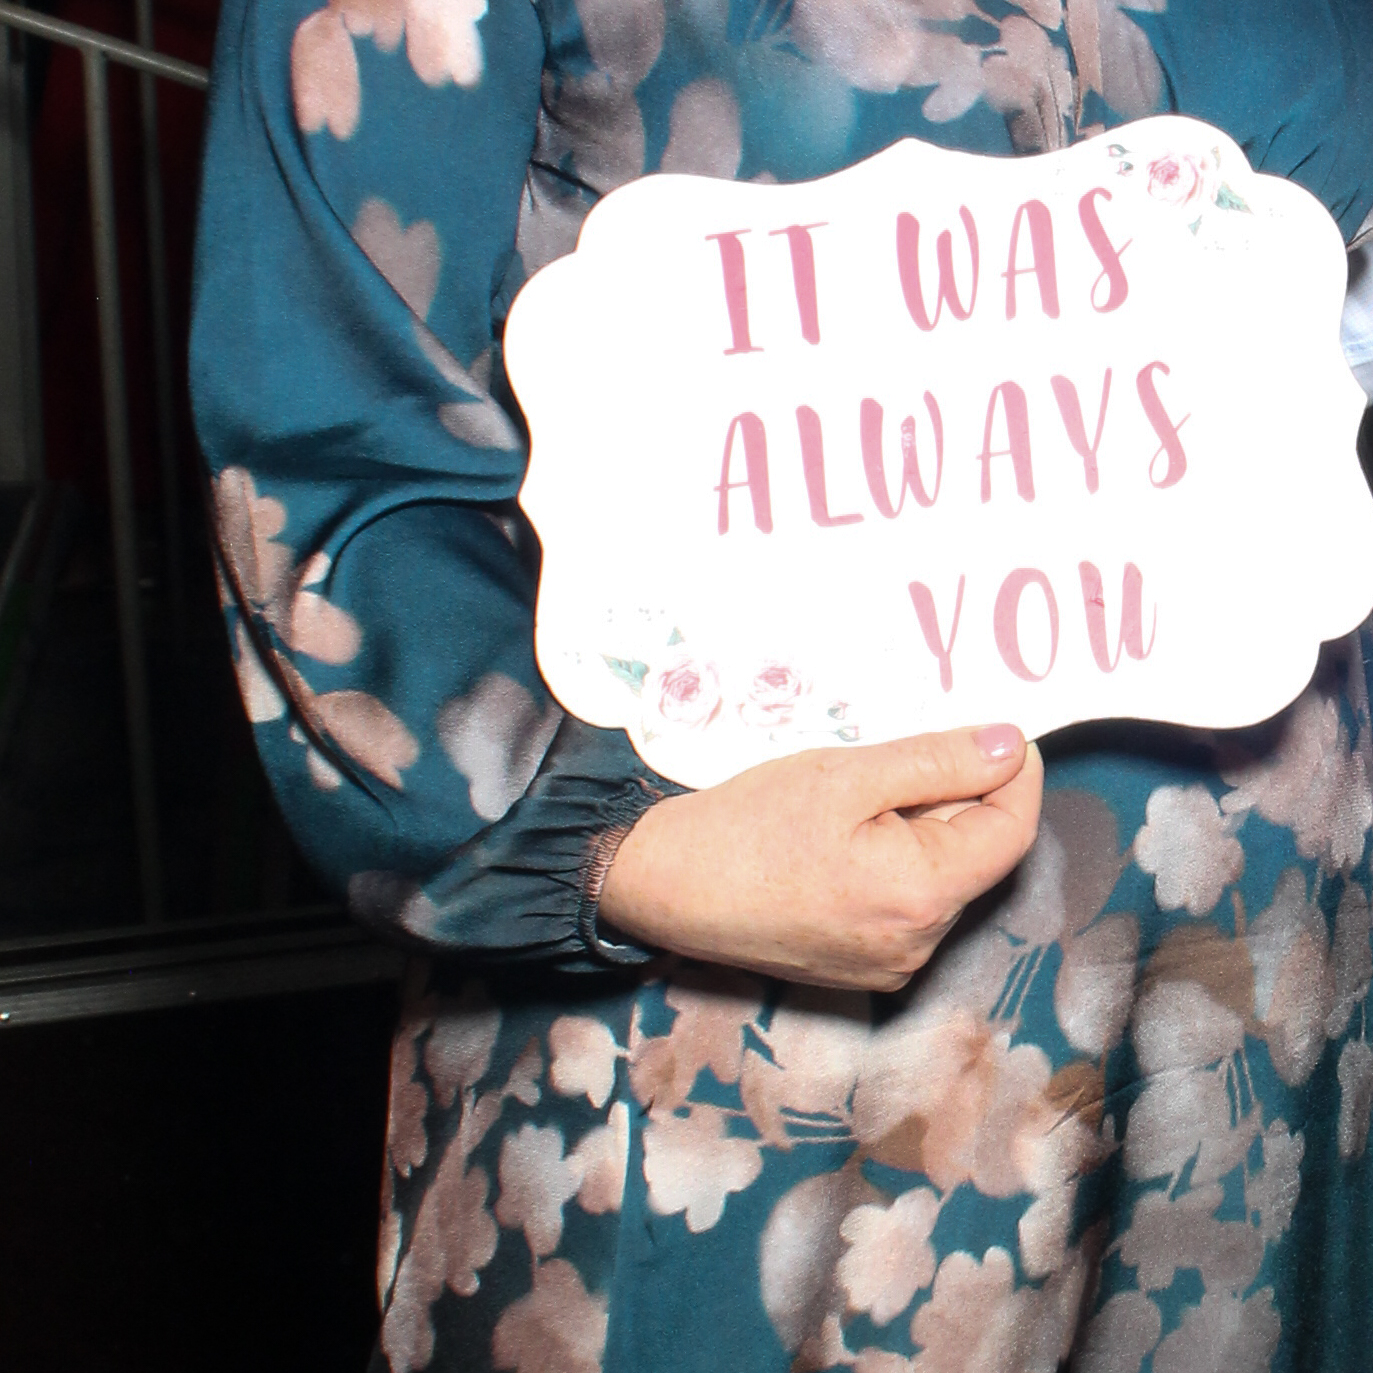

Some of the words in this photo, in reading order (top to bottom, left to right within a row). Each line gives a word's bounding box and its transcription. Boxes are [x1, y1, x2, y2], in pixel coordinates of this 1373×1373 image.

[705, 223, 829, 356] IT
[896, 187, 1133, 332] WAS
[713, 360, 1190, 535] ALWAYS
[907, 561, 1158, 693] YOU
